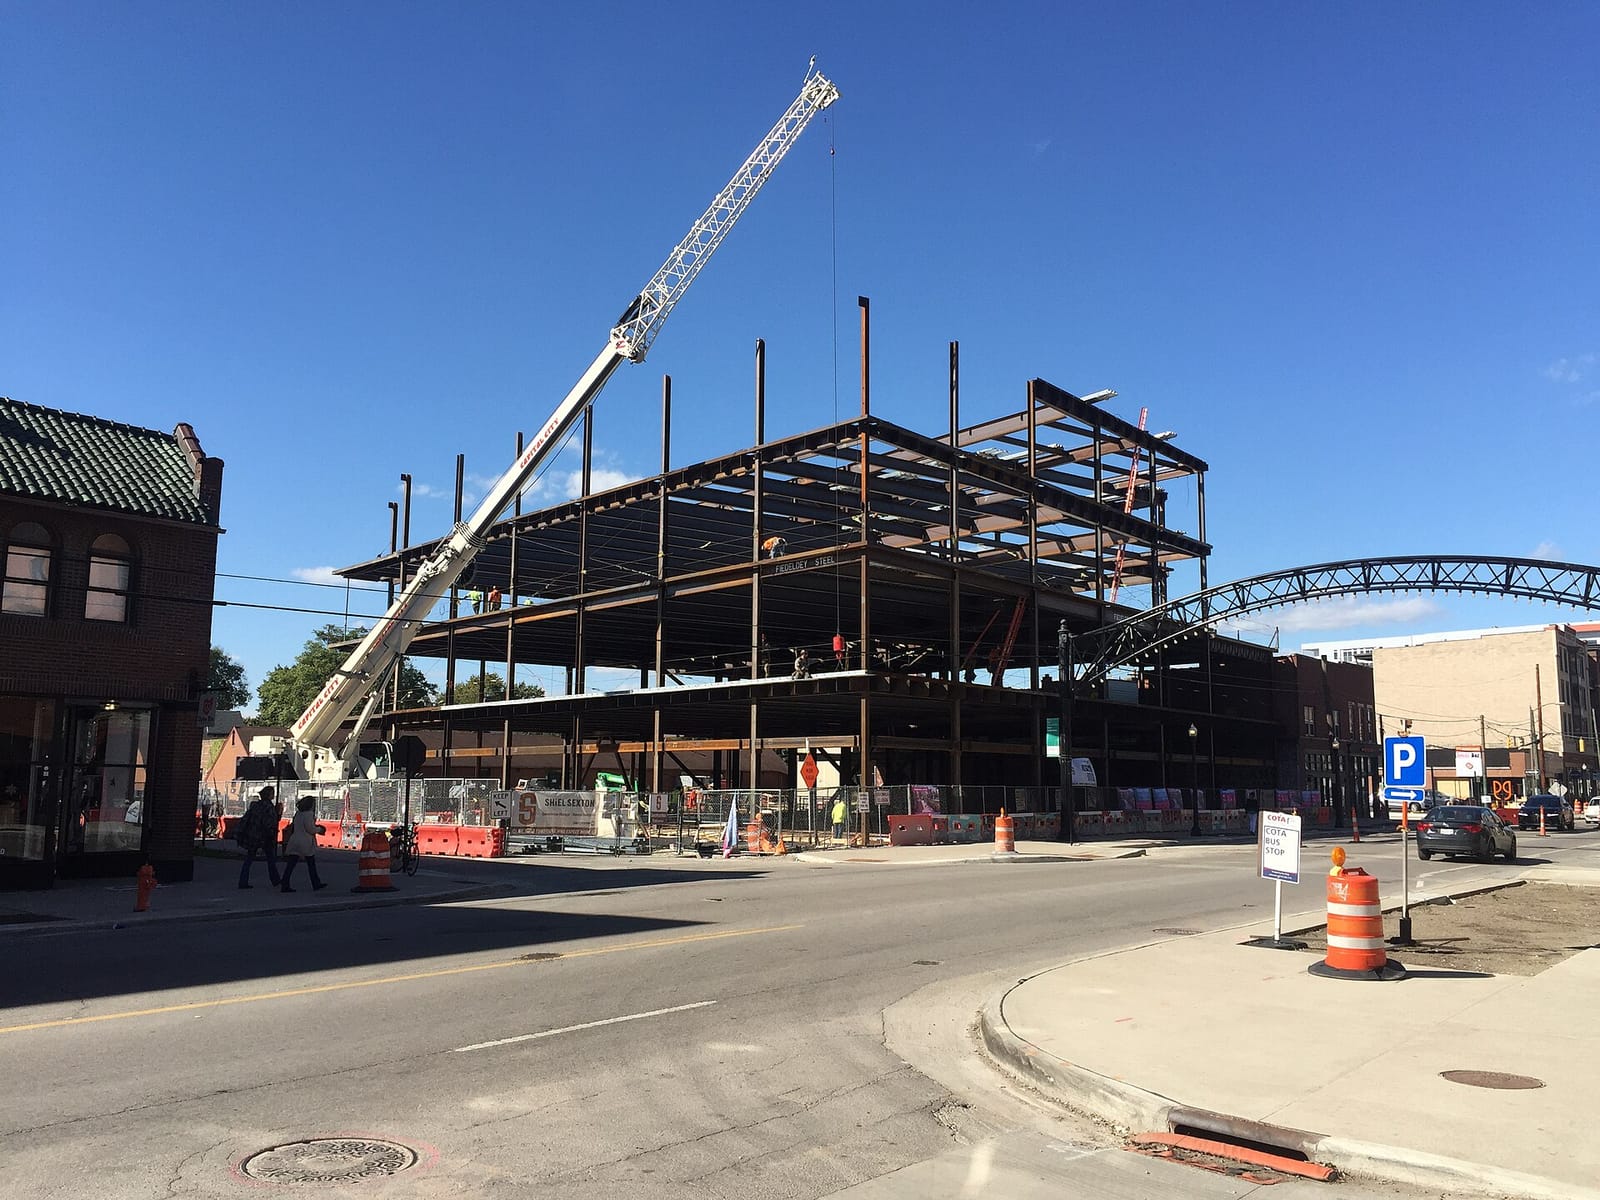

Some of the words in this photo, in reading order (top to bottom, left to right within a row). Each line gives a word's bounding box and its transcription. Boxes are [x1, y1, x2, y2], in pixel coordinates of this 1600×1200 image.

[520, 437, 545, 469] CAPITAL
[544, 418, 559, 438] CITY
[815, 556, 834, 566] STEEL
[298, 698, 323, 730] CAPITAL
[323, 678, 339, 698] CITY
[1393, 743, 1416, 780] P
[567, 798, 595, 808] SEXTON
[1267, 814, 1286, 823] COTA
[1265, 828, 1287, 837] COTA
[1265, 837, 1281, 846] BUS
[1265, 847, 1285, 856] STOP
